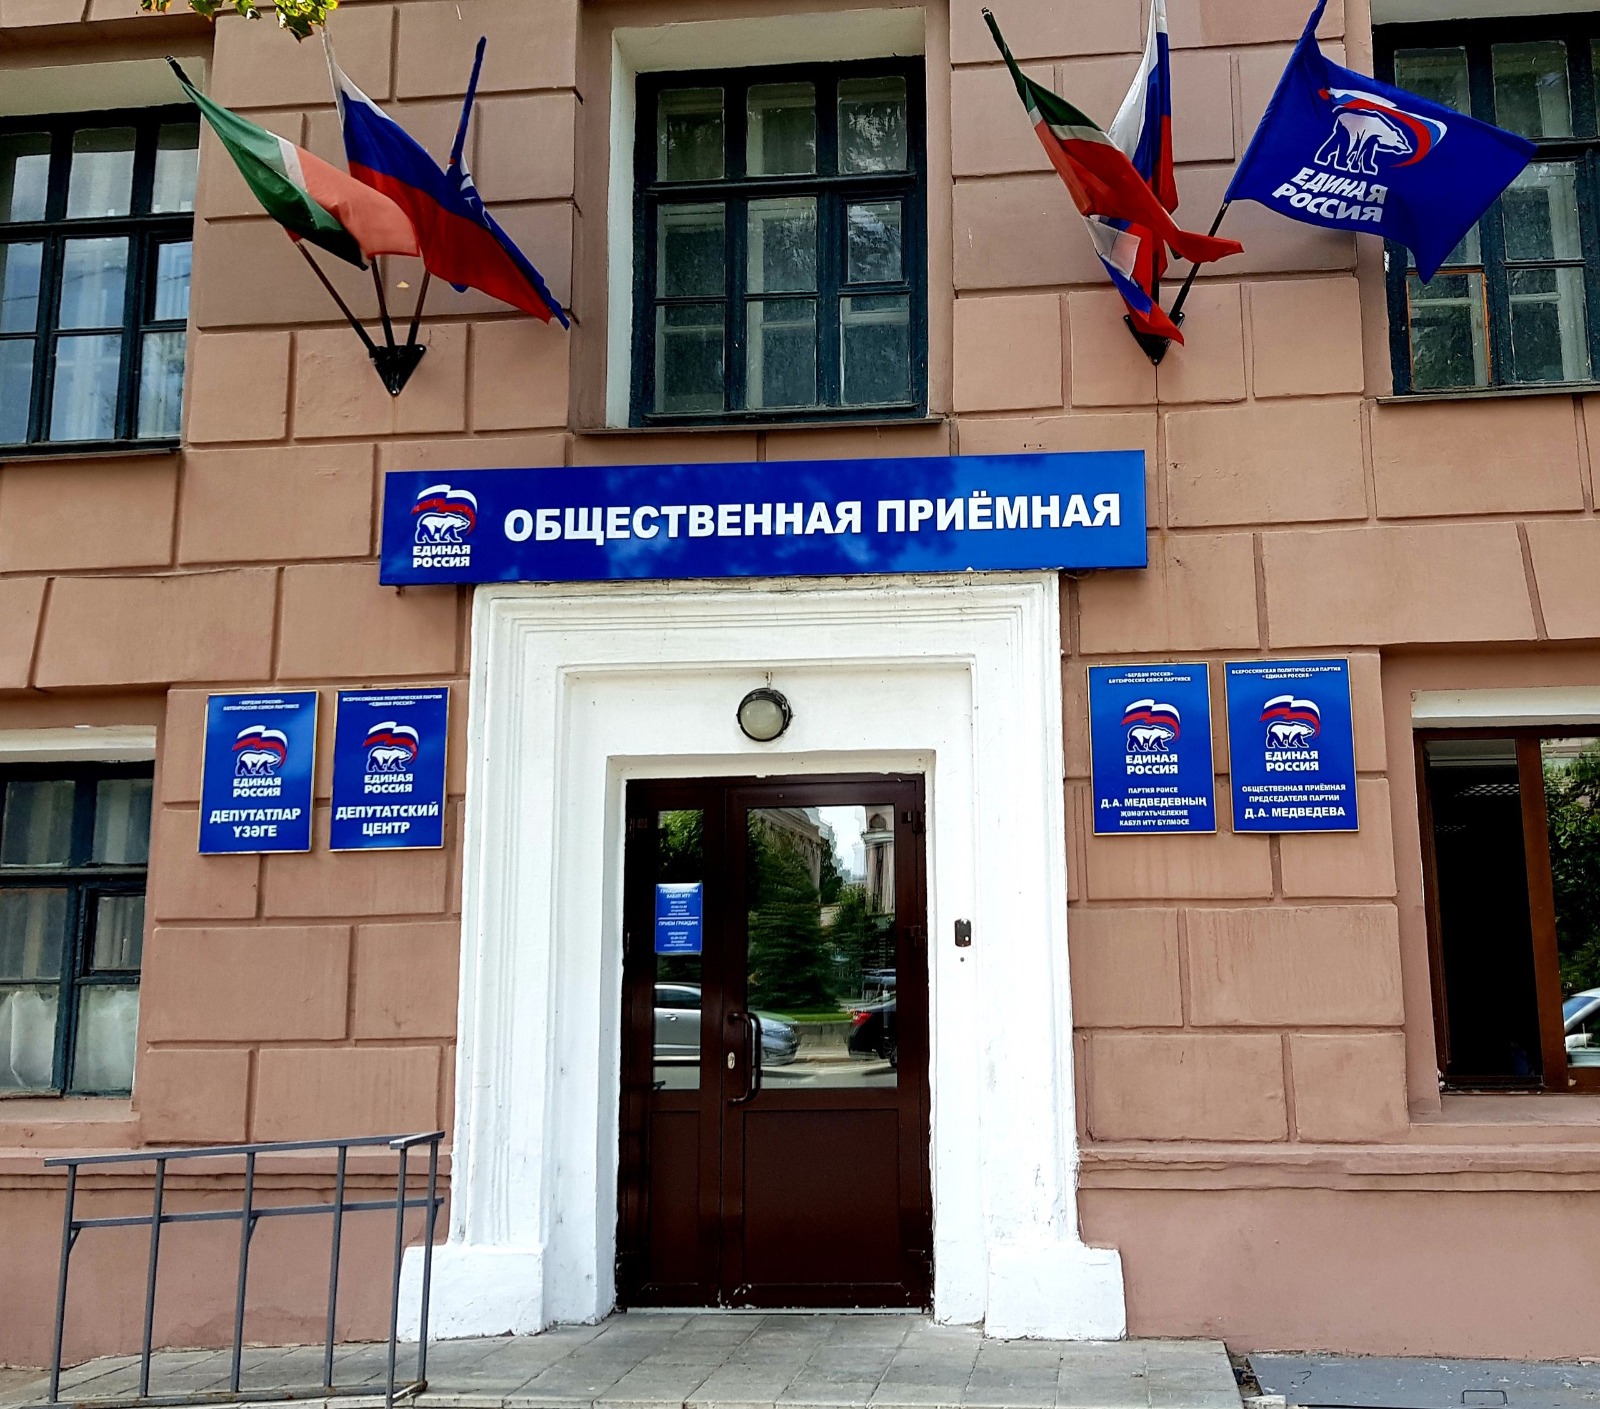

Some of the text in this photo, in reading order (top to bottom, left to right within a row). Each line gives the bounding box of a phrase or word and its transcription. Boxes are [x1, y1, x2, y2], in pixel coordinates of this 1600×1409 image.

[1291, 166, 1388, 205] ЕДИНАЯ
[1272, 183, 1383, 223] РОССИЯ
[504, 490, 1121, 546] ОБЩЕСТВЕННАЯ ПРИЁМНАЯ
[412, 544, 471, 558] ЕДИНАЯ
[412, 556, 470, 568] РОССИЯ
[1126, 754, 1178, 764] ЕДИНАЯ
[1265, 750, 1318, 761] ЕДИНАЯ
[1127, 764, 1178, 774] РОССИЯ
[1266, 761, 1319, 772] РОССИЯ
[233, 777, 282, 787] ЕДИНАЯ
[364, 774, 414, 784] ЕДИНАЯ
[233, 787, 281, 798] РОССИЯ
[364, 784, 413, 794] РОССИЯ
[1242, 783, 1346, 793] ОБЩЕСТВЕННАЯ ПРИЁМНАЯ
[1124, 797, 1207, 808] МЕДВЕДЕВНЫҢ
[1249, 795, 1308, 803] ПРЕДСЕДАТЕЛЯ
[210, 808, 301, 824] ДЕПУТАТЛАР
[336, 801, 438, 820] ДЕПУТАТСКИЙ
[1272, 807, 1345, 818] МЕДВЕДЕВА
[233, 825, 277, 838] ҮЗӘГЕ
[362, 822, 410, 837] ЦЕНТР
